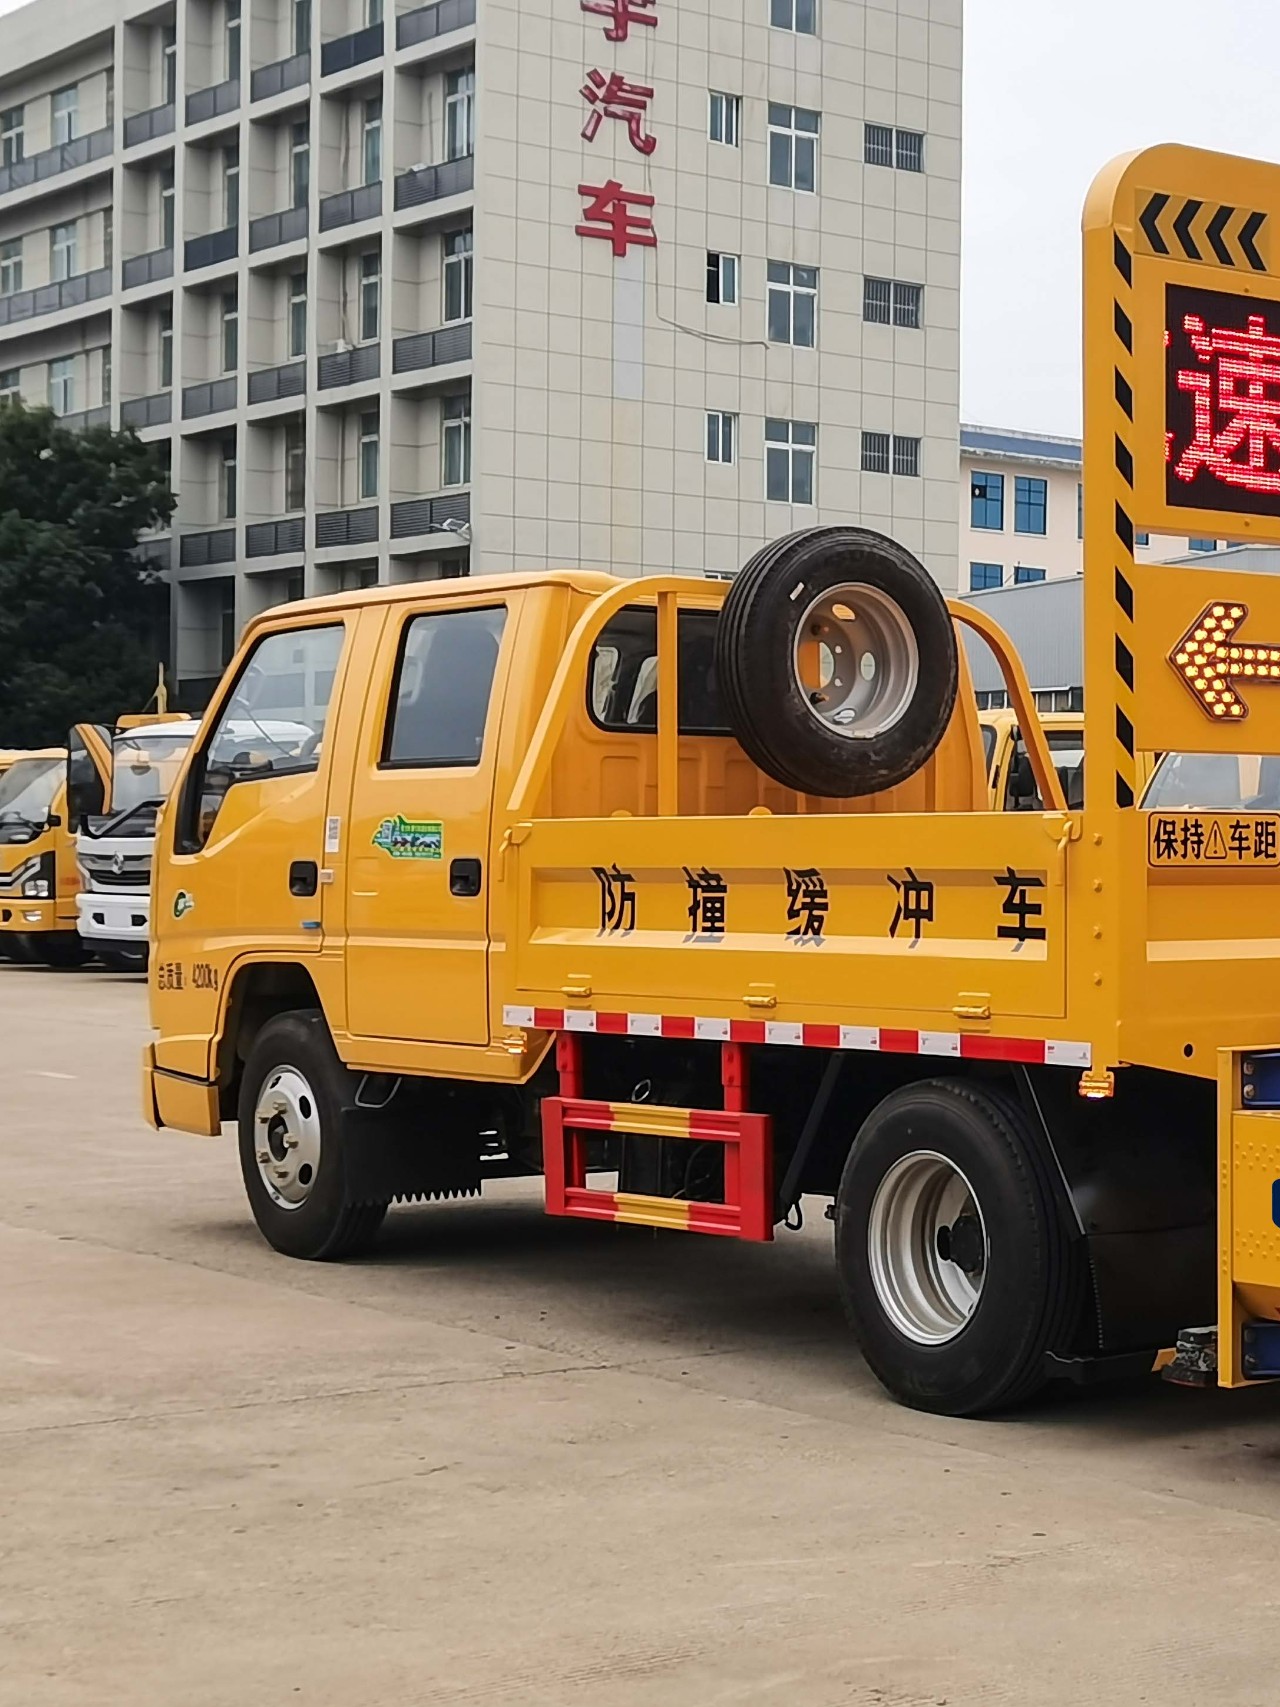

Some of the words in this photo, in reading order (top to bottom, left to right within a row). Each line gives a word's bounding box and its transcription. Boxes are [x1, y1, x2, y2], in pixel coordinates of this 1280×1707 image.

[590, 862, 1047, 943] 防撞缓冲车
